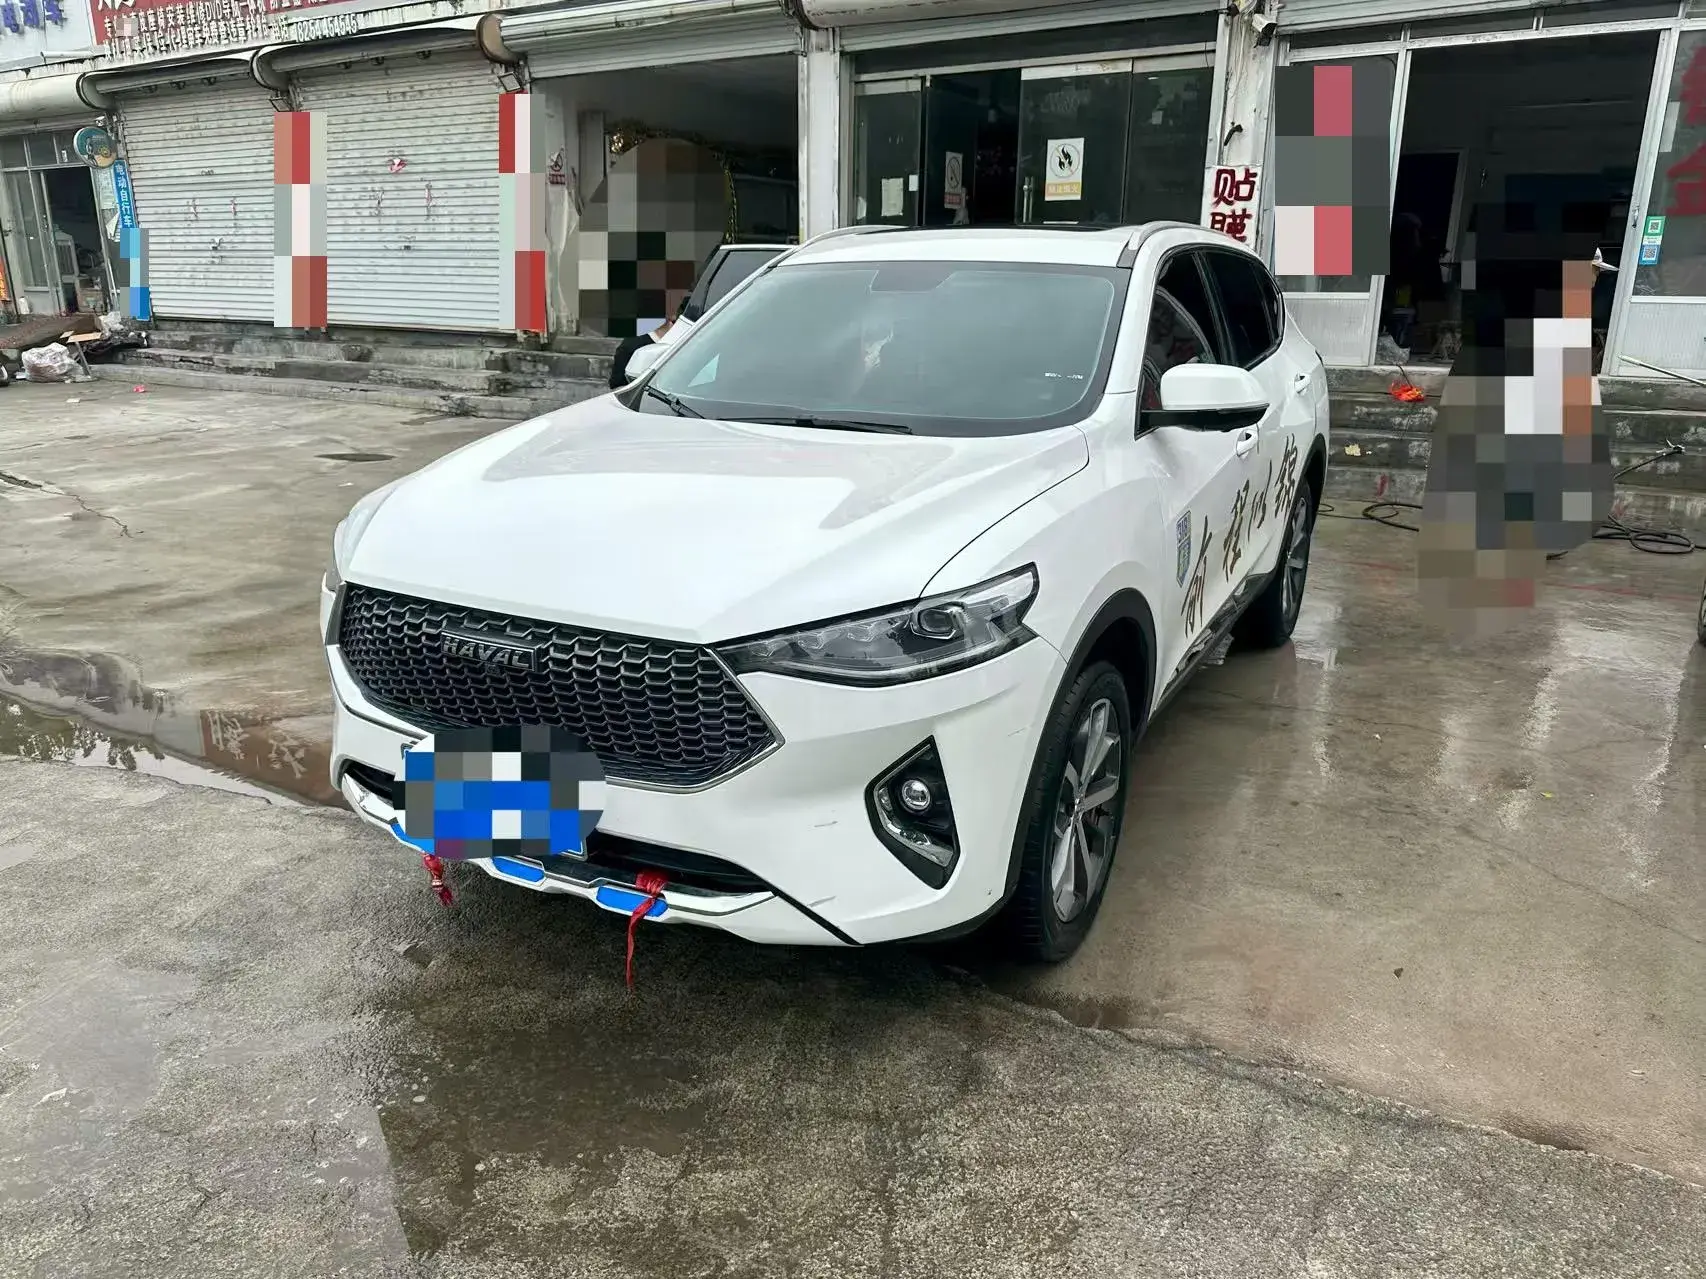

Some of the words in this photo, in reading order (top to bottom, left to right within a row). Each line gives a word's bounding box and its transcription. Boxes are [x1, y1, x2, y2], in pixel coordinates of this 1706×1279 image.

[115, 163, 133, 227] 电动自行车
[443, 637, 529, 666] HAVAL
